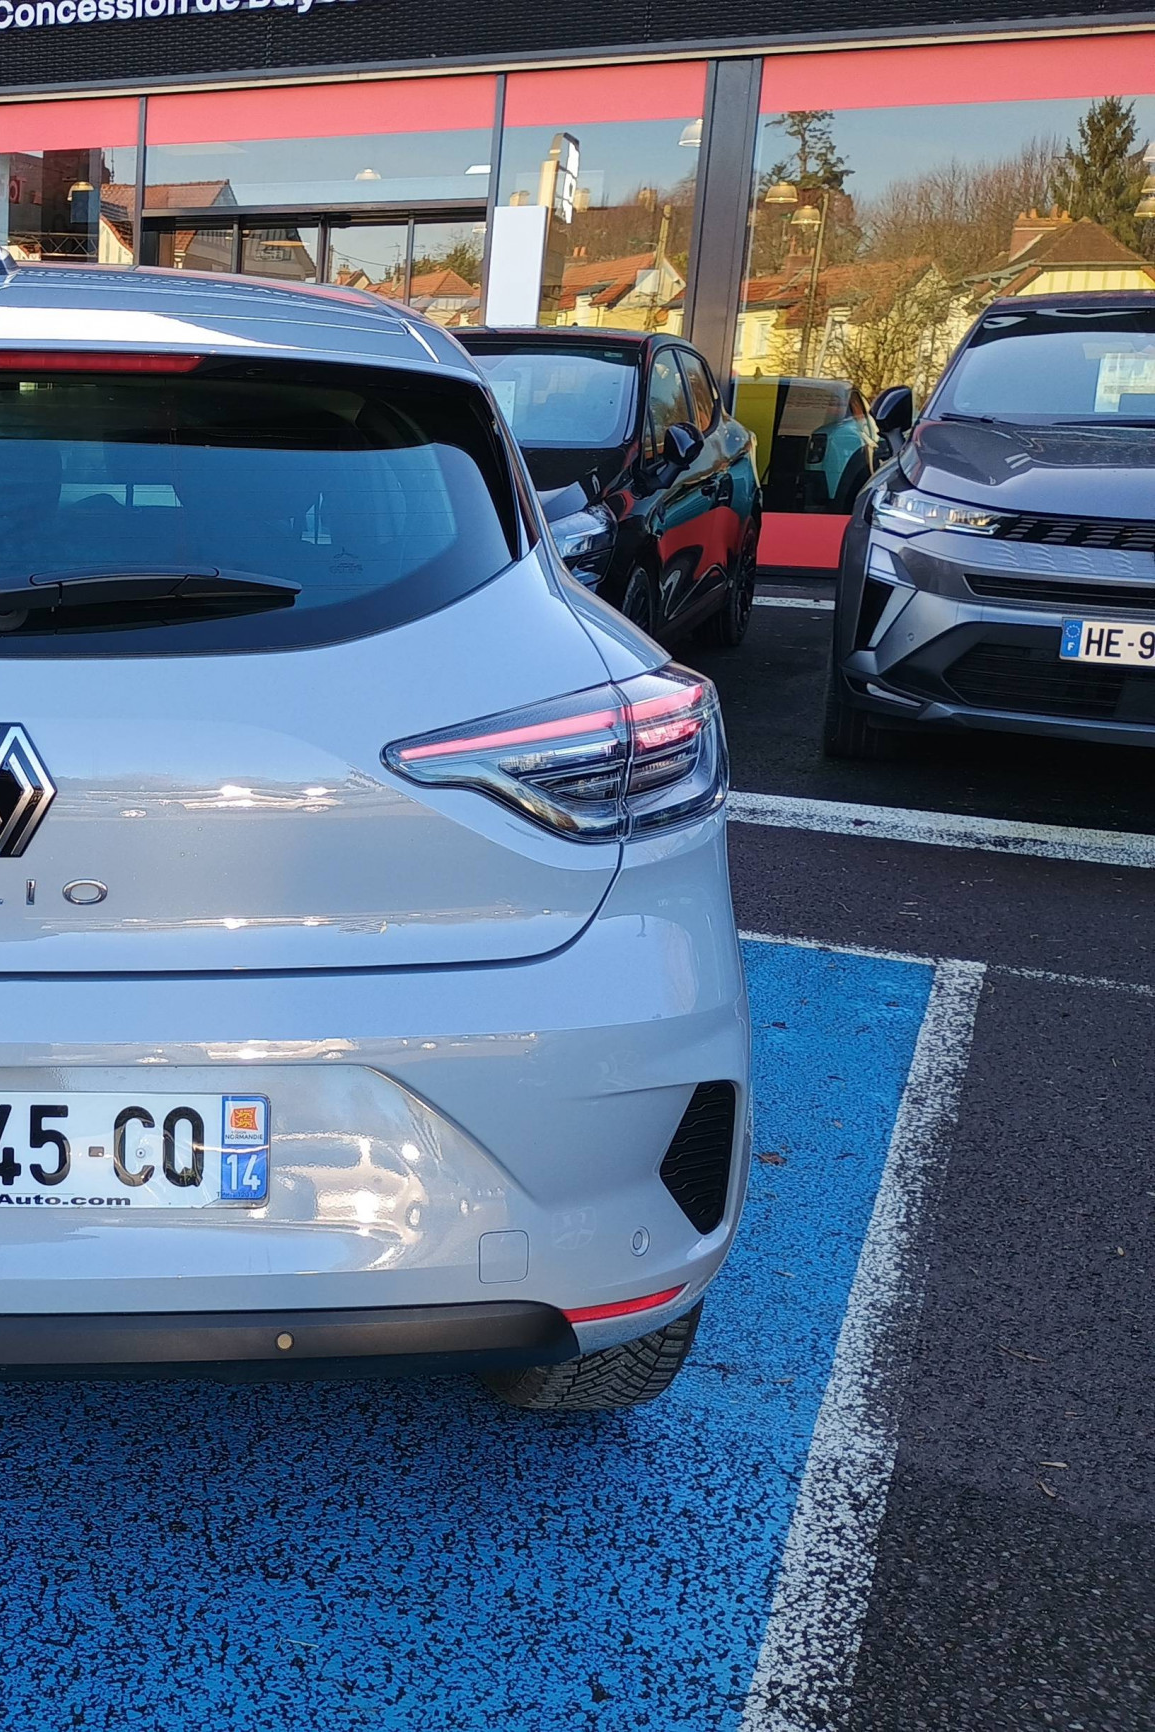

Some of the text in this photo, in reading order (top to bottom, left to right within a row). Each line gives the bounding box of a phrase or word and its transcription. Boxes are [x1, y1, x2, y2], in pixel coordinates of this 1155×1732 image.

[1068, 642, 1075, 651] F
[1085, 628, 1155, 660] HE-9
[227, 1154, 261, 1190] 14
